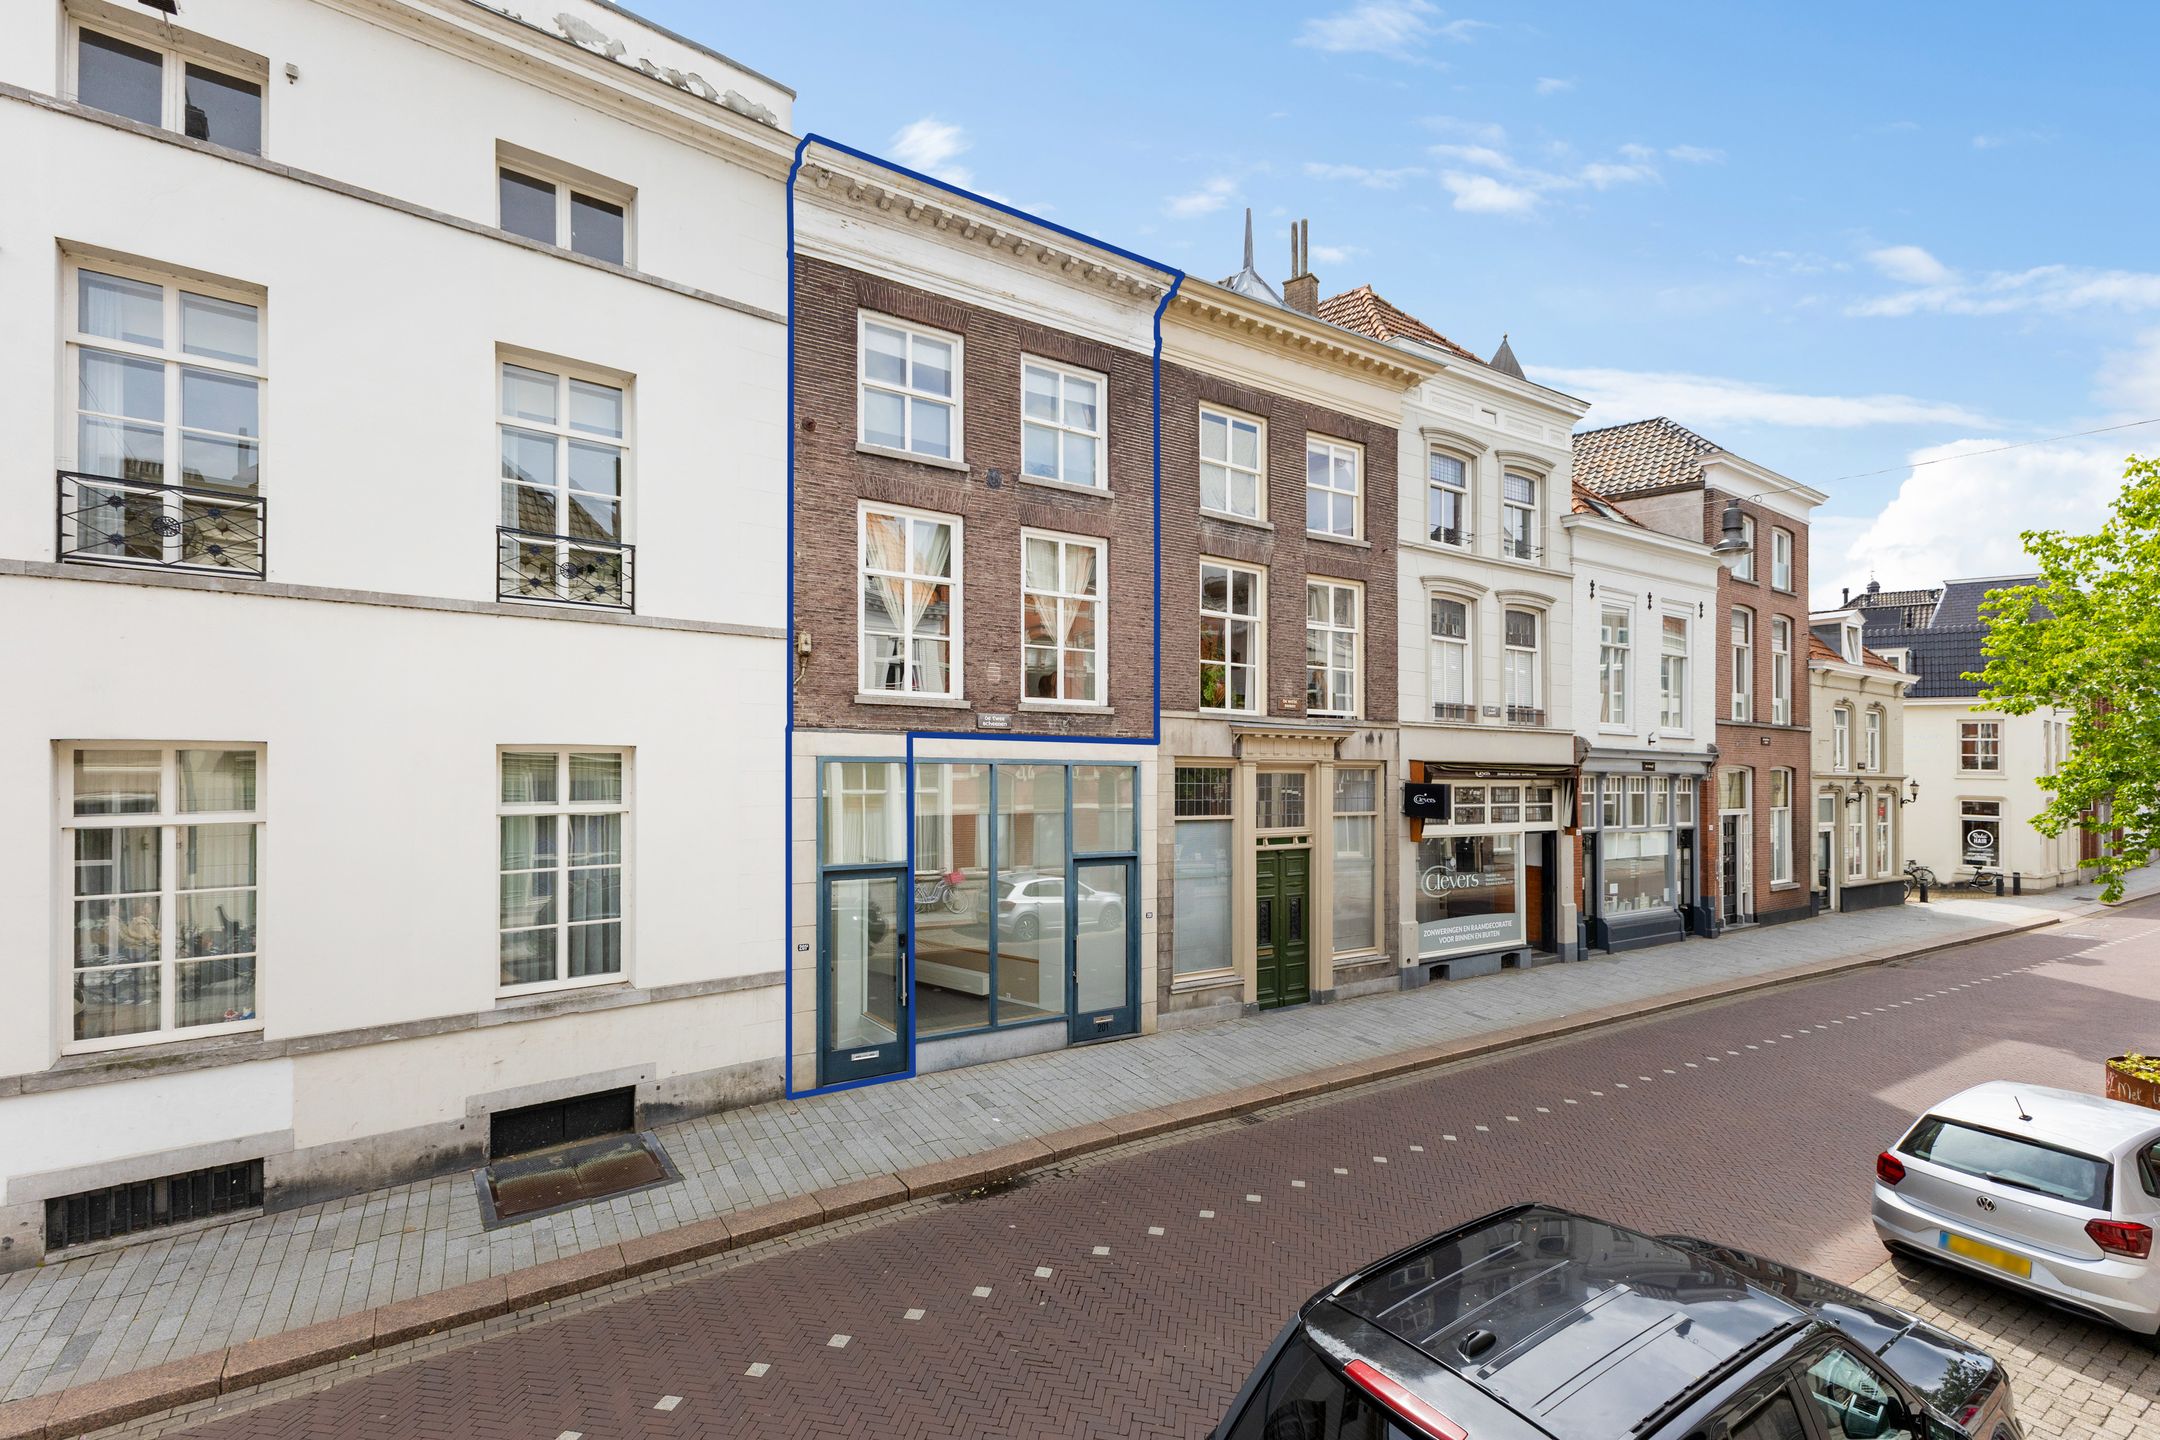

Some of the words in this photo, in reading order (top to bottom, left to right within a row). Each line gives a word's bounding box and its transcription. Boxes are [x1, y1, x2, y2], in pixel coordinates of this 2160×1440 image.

[1423, 926, 1463, 937] ZONWERINGEN
[1463, 924, 1471, 932] EN
[1471, 920, 1513, 931] RAAMDECORATIE
[1438, 935, 1455, 944] VOOR
[1455, 932, 1475, 942] BINNEN
[1475, 931, 1482, 939] EN
[1482, 930, 1501, 938] BUITEN
[1097, 1022, 1109, 1032] 201
